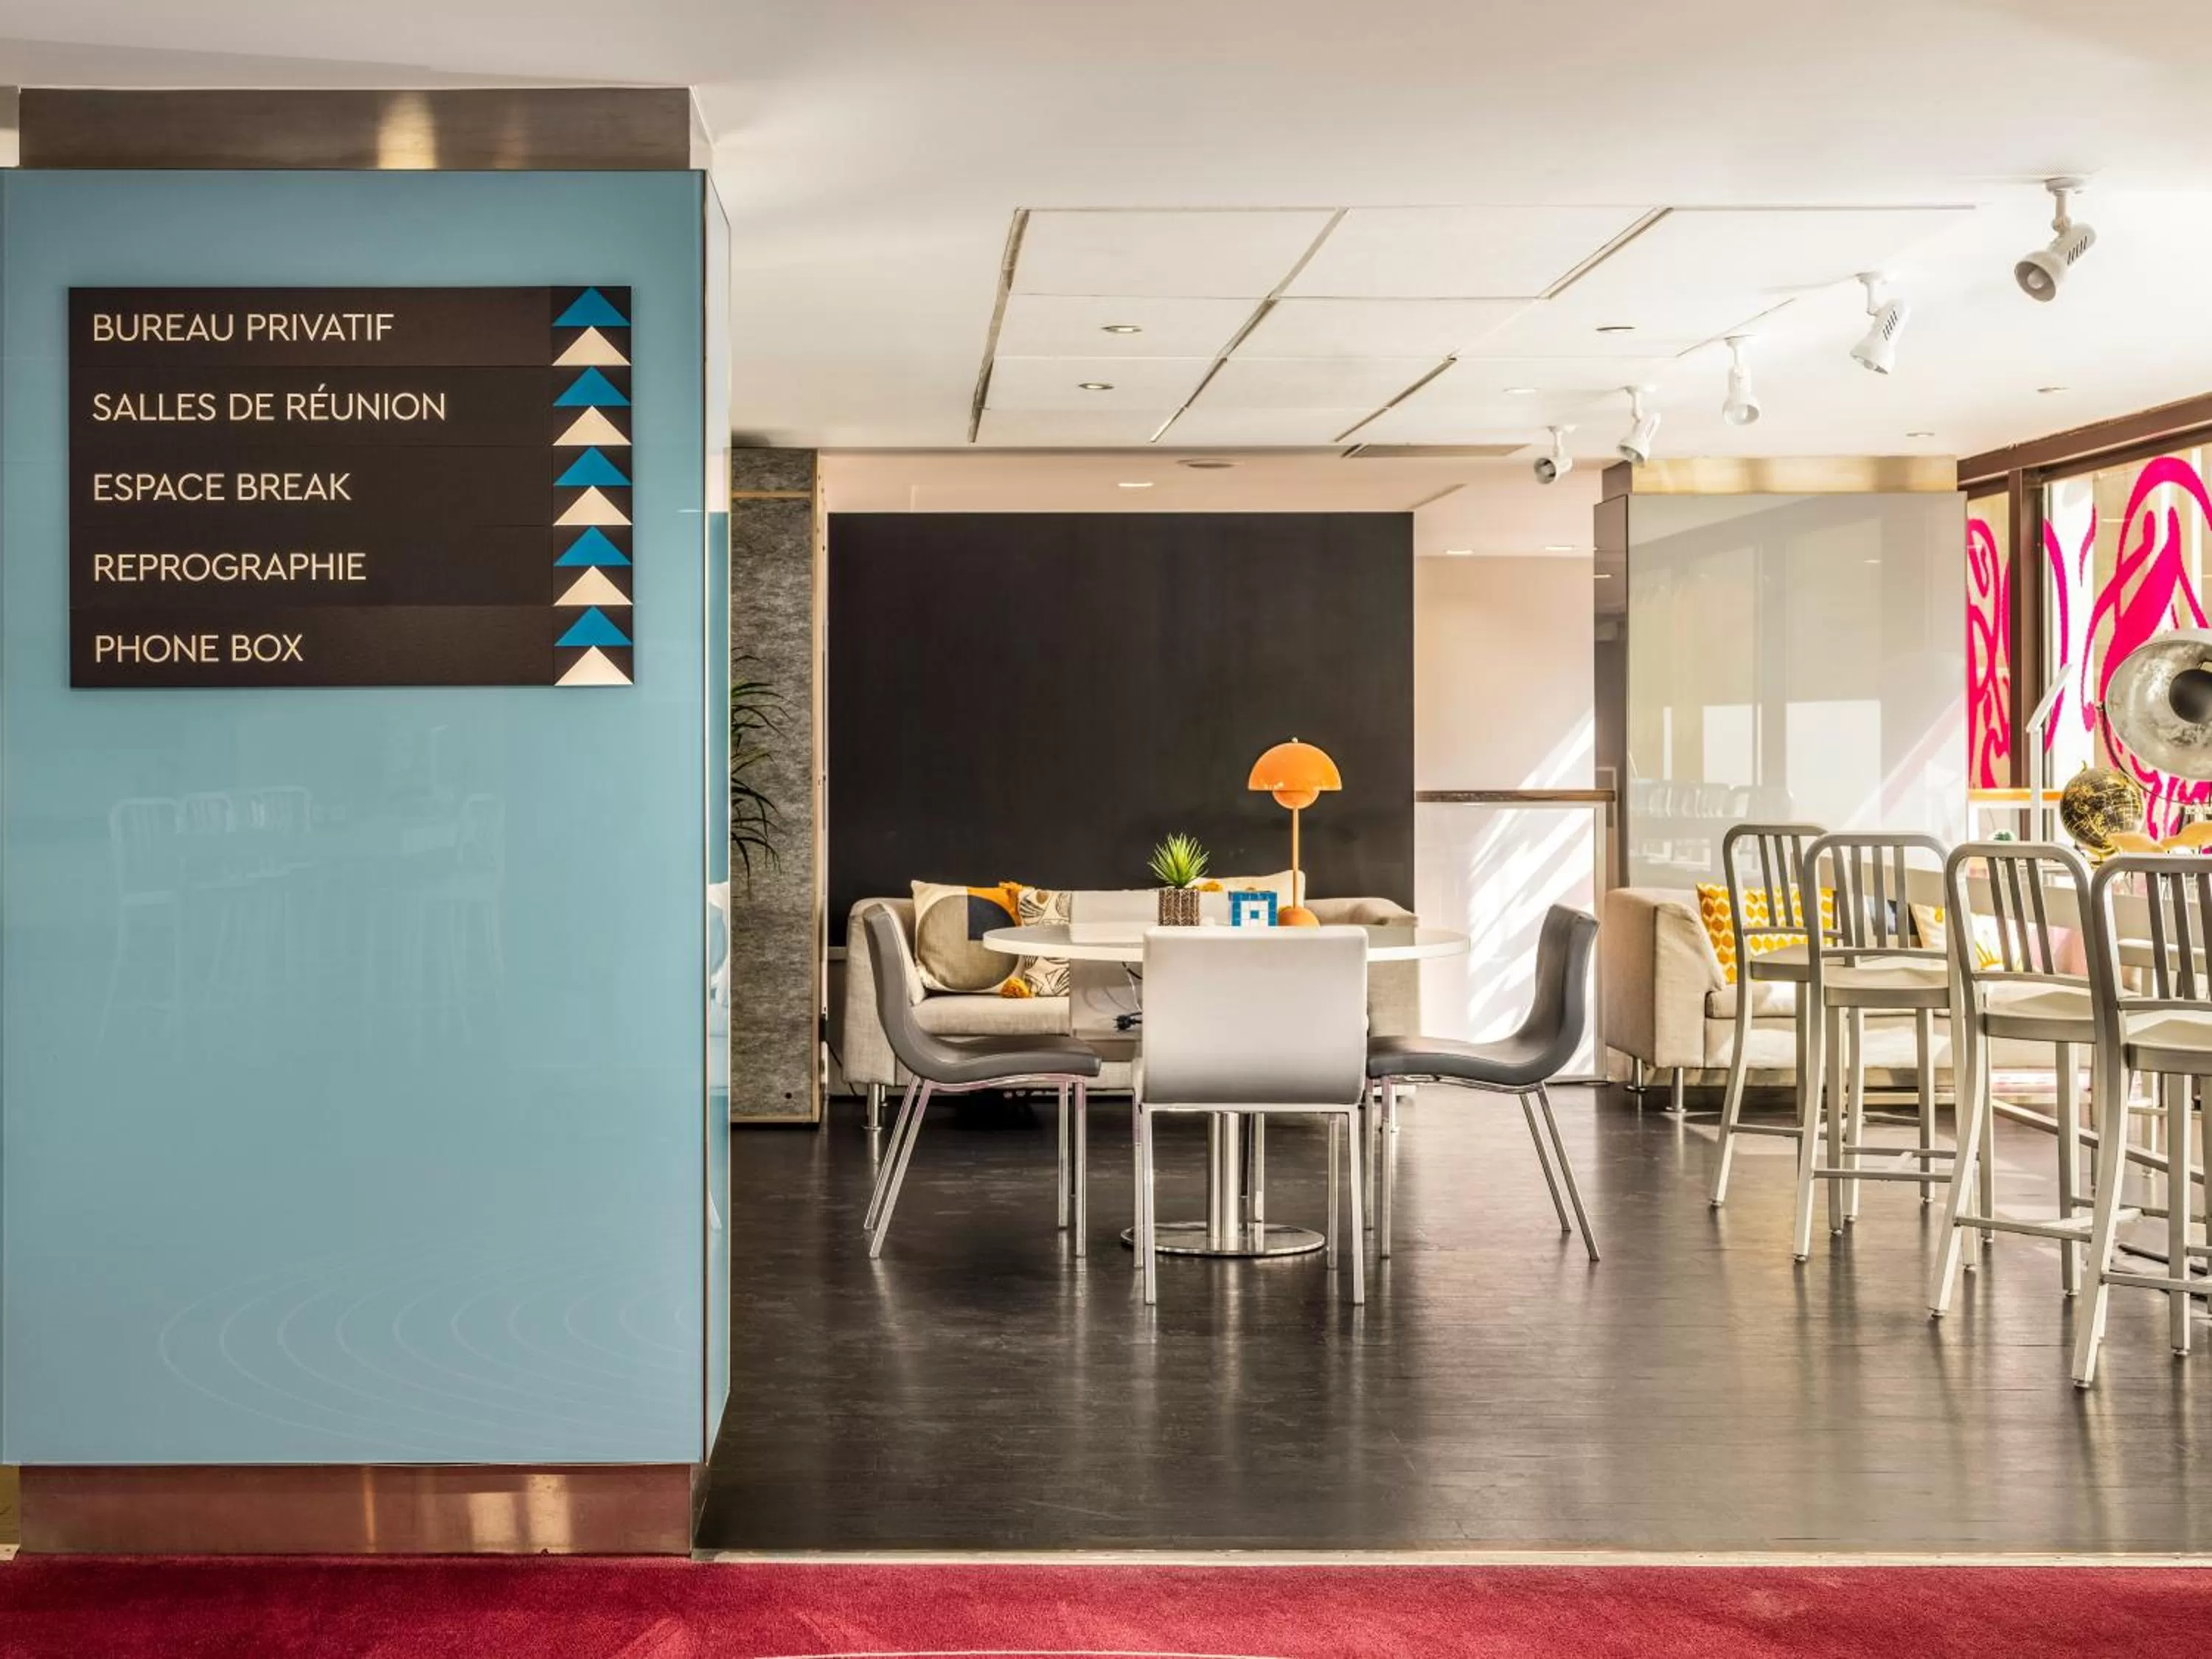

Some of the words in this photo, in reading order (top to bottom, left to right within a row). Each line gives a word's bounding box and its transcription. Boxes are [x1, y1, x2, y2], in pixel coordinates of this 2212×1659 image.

[93, 313, 234, 342] BUREAU
[246, 313, 395, 342] PRIVATIF
[91, 392, 216, 422] SALLES
[229, 392, 276, 422] DE
[286, 383, 446, 422] RÉUNION
[93, 472, 226, 502] ESPACE
[237, 472, 352, 501] BREAK
[94, 552, 367, 582] REPROGRAPHIE
[95, 634, 220, 664] PHONE
[231, 633, 305, 663] BOX
